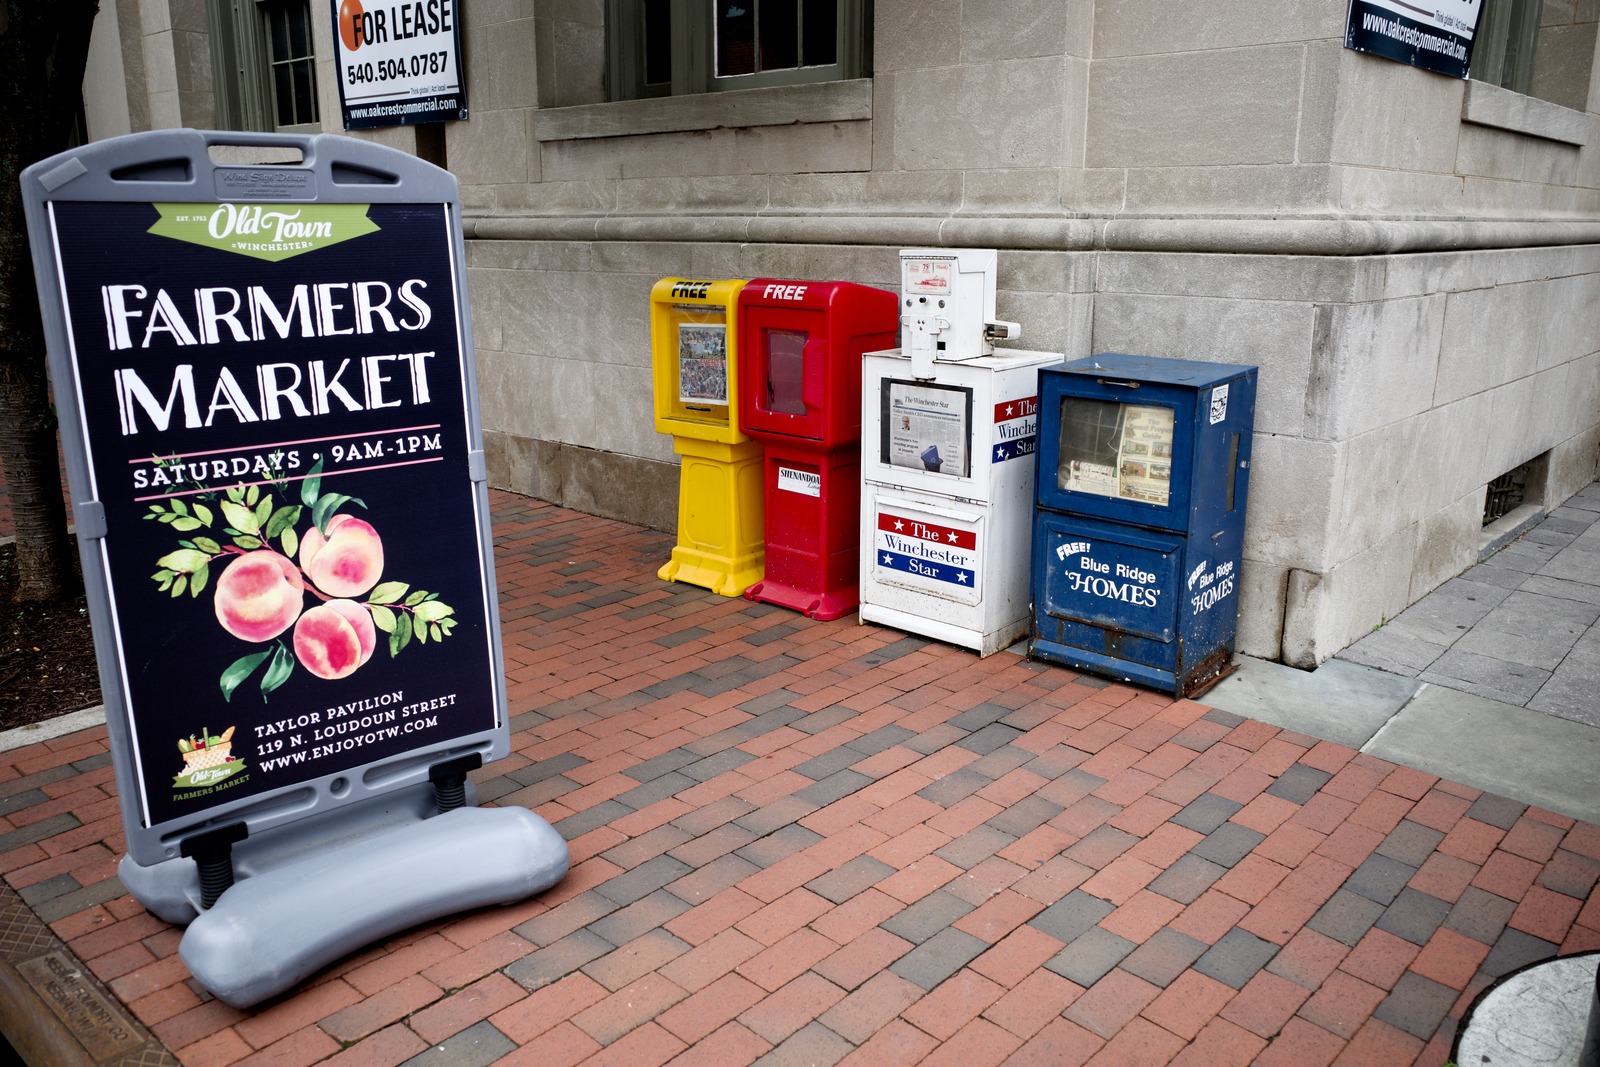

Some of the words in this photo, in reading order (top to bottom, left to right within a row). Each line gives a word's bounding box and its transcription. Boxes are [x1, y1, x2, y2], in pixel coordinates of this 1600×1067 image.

[353, 9, 388, 48] FOR
[391, 0, 452, 41] LEASE
[1362, 12, 1466, 61] www.oakcrestcommercial.com
[347, 50, 448, 85] 540.504.0787
[350, 97, 457, 119] www.oakcrestcommercial.com
[220, 171, 248, 182] Wind
[250, 172, 273, 184] Sign
[274, 172, 308, 182] Deluxe
[208, 203, 262, 240] Old
[261, 209, 332, 242] Town
[236, 241, 309, 252] WINCHESTER
[671, 281, 712, 299] FREE
[763, 284, 808, 300] FREE
[101, 279, 432, 351] FARMERS
[113, 351, 436, 436] MARKET
[914, 397, 939, 407] Winchester
[1018, 400, 1037, 416] The
[133, 450, 301, 489] SATURDAYS
[332, 433, 442, 463] 9AM-1PM
[910, 522, 940, 540] The
[884, 534, 968, 566] Winchester
[1056, 542, 1091, 561] FREE!
[908, 559, 940, 578] Star
[1080, 556, 1110, 574] Blue
[1116, 563, 1156, 584] Ridge
[1187, 560, 1207, 592] FREE!
[1200, 574, 1214, 589] Blue
[1215, 560, 1234, 580] Ridge
[254, 712, 321, 738] TAYLOR
[327, 690, 404, 720] PAVILION
[256, 740, 284, 756] 119
[290, 734, 308, 748] N.
[314, 709, 397, 742] LOUDOUN
[402, 693, 458, 718] STREET
[259, 715, 439, 773] WWW.ENJOYOTW.COM
[172, 787, 214, 802] FARMERS
[215, 773, 250, 792] MARKET
[190, 770, 208, 784] Old
[208, 767, 232, 780] Town
